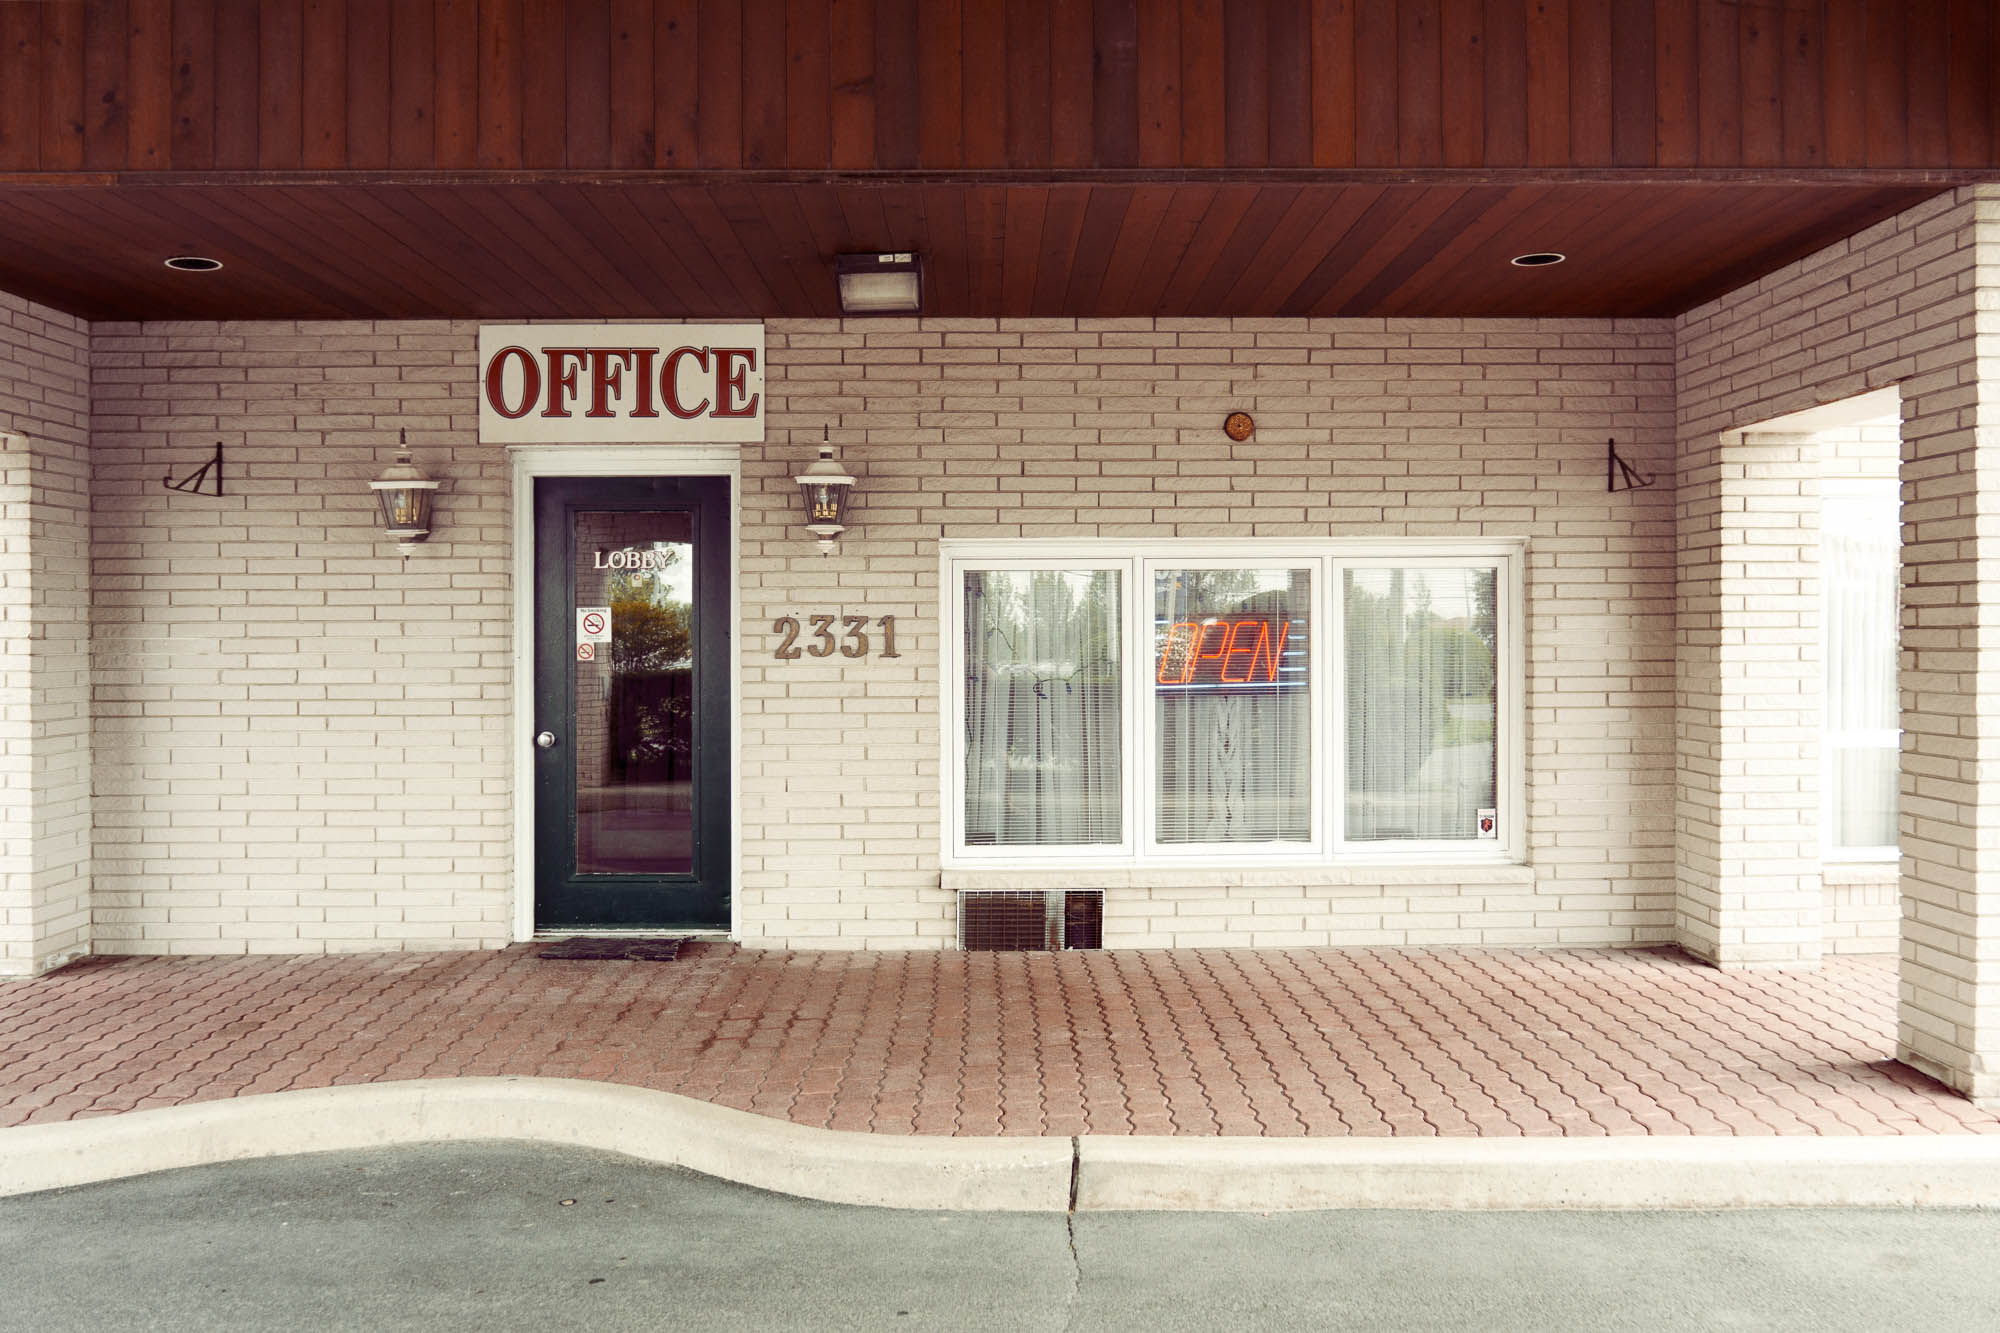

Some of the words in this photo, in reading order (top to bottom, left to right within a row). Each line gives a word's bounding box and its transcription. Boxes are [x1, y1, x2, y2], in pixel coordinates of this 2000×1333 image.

[485, 345, 759, 419] OFFICE
[594, 551, 674, 569] LOBBY
[773, 614, 901, 659] 2331
[1158, 621, 1288, 684] OPEN
